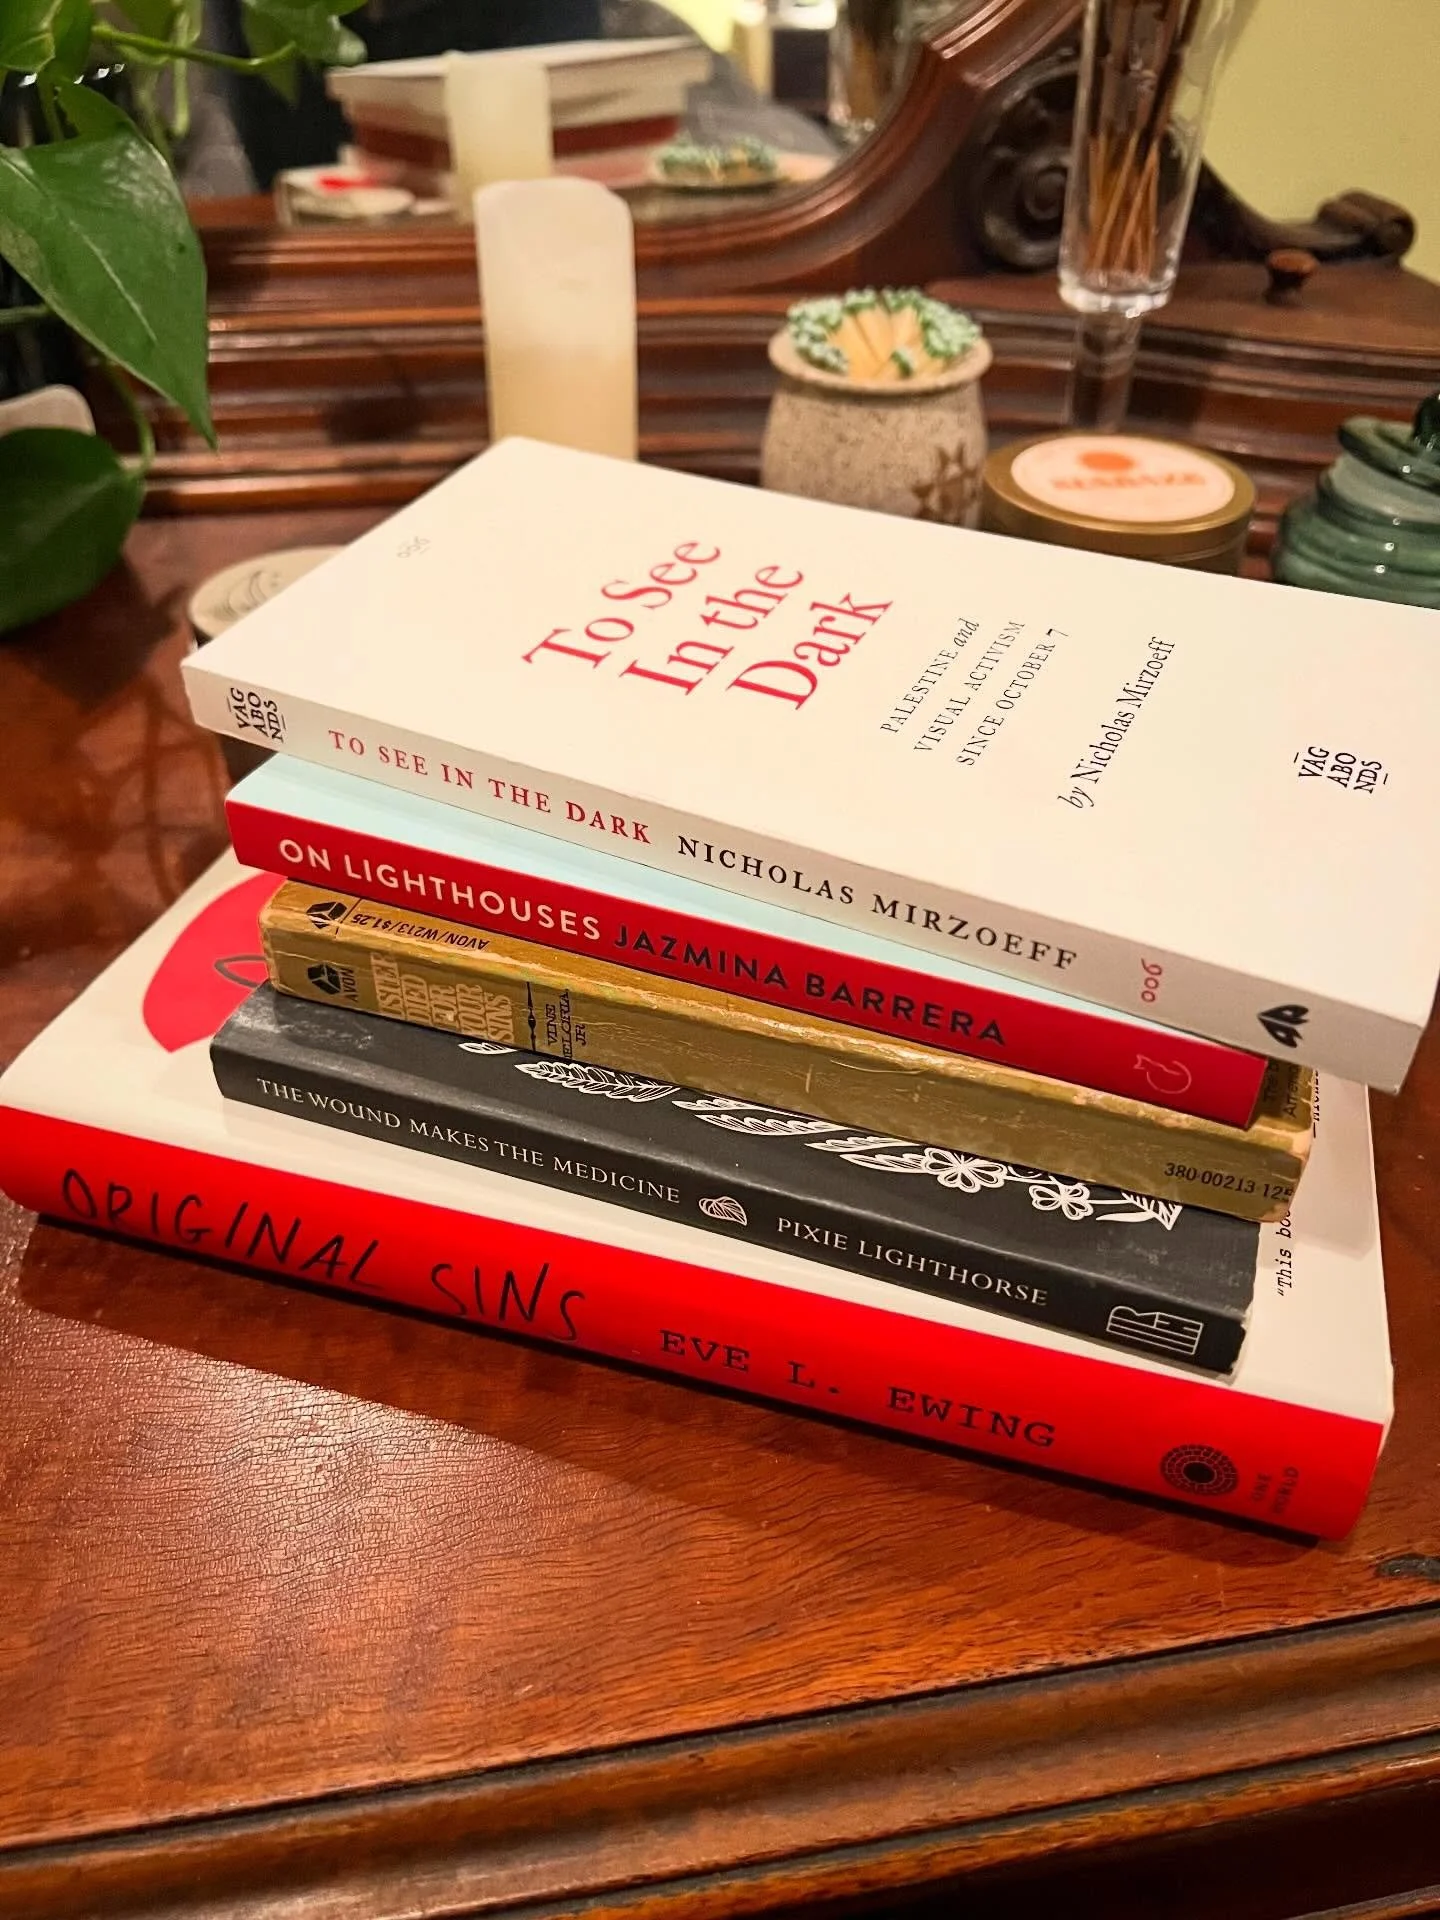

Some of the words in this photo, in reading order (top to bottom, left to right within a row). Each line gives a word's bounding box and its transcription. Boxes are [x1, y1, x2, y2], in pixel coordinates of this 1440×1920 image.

[521, 617, 635, 669] To
[601, 541, 721, 610] See
[619, 640, 735, 696] In
[700, 565, 804, 629] the
[726, 593, 893, 711] Dark
[880, 649, 959, 733] PALESTINE
[953, 617, 980, 648] and
[913, 695, 971, 751] VISUAL
[963, 621, 1026, 691] ACTIVISM
[1116, 636, 1175, 708] Mirzoeff
[230, 687, 251, 729] VAG
[247, 691, 269, 737] ABO
[264, 700, 284, 743] NDS
[956, 714, 1005, 766] SINCE
[995, 642, 1056, 710] OCTOBER
[1046, 628, 1069, 638] 7
[1070, 710, 1135, 784] Nicholas
[1298, 746, 1330, 777] VAG
[1326, 752, 1356, 788] ABO
[1353, 761, 1382, 794] NDS
[1057, 786, 1094, 809] by
[328, 729, 365, 756] TO
[378, 745, 428, 776] SEE
[441, 763, 473, 788] IN
[488, 777, 552, 813] THE
[565, 800, 651, 844] DARK
[677, 835, 855, 904] NICHOLAS
[870, 893, 1078, 970] MIRZOEFF
[279, 837, 331, 873] ON
[344, 854, 601, 940] LIGHTHOUSES
[613, 923, 789, 989] JAZMINA
[805, 974, 1006, 1047] BARRERA
[351, 913, 490, 950] AVON/W213/$1.25
[340, 967, 357, 1001] AVON
[370, 950, 404, 1017] USTER
[400, 974, 434, 1023] DIED
[428, 983, 457, 1028] FOR
[456, 982, 488, 1037] YOUR
[486, 992, 514, 1043] SINS
[545, 1004, 558, 1045] VINE
[559, 988, 573, 1060] ELORIA,
[257, 1077, 304, 1103] THE
[306, 1092, 401, 1129] WOUND
[409, 1118, 490, 1153] MAKES
[494, 1140, 544, 1168] THE
[553, 1156, 680, 1204] MEDICINE
[62, 1168, 389, 1289] ORIGINAL
[430, 1262, 585, 1340] SINS
[777, 1217, 848, 1251] PIXIE
[858, 1239, 1048, 1307] LIGHTHORSE
[659, 1329, 750, 1372] EVE
[788, 1360, 840, 1394] L.
[888, 1386, 1056, 1448] EWING
